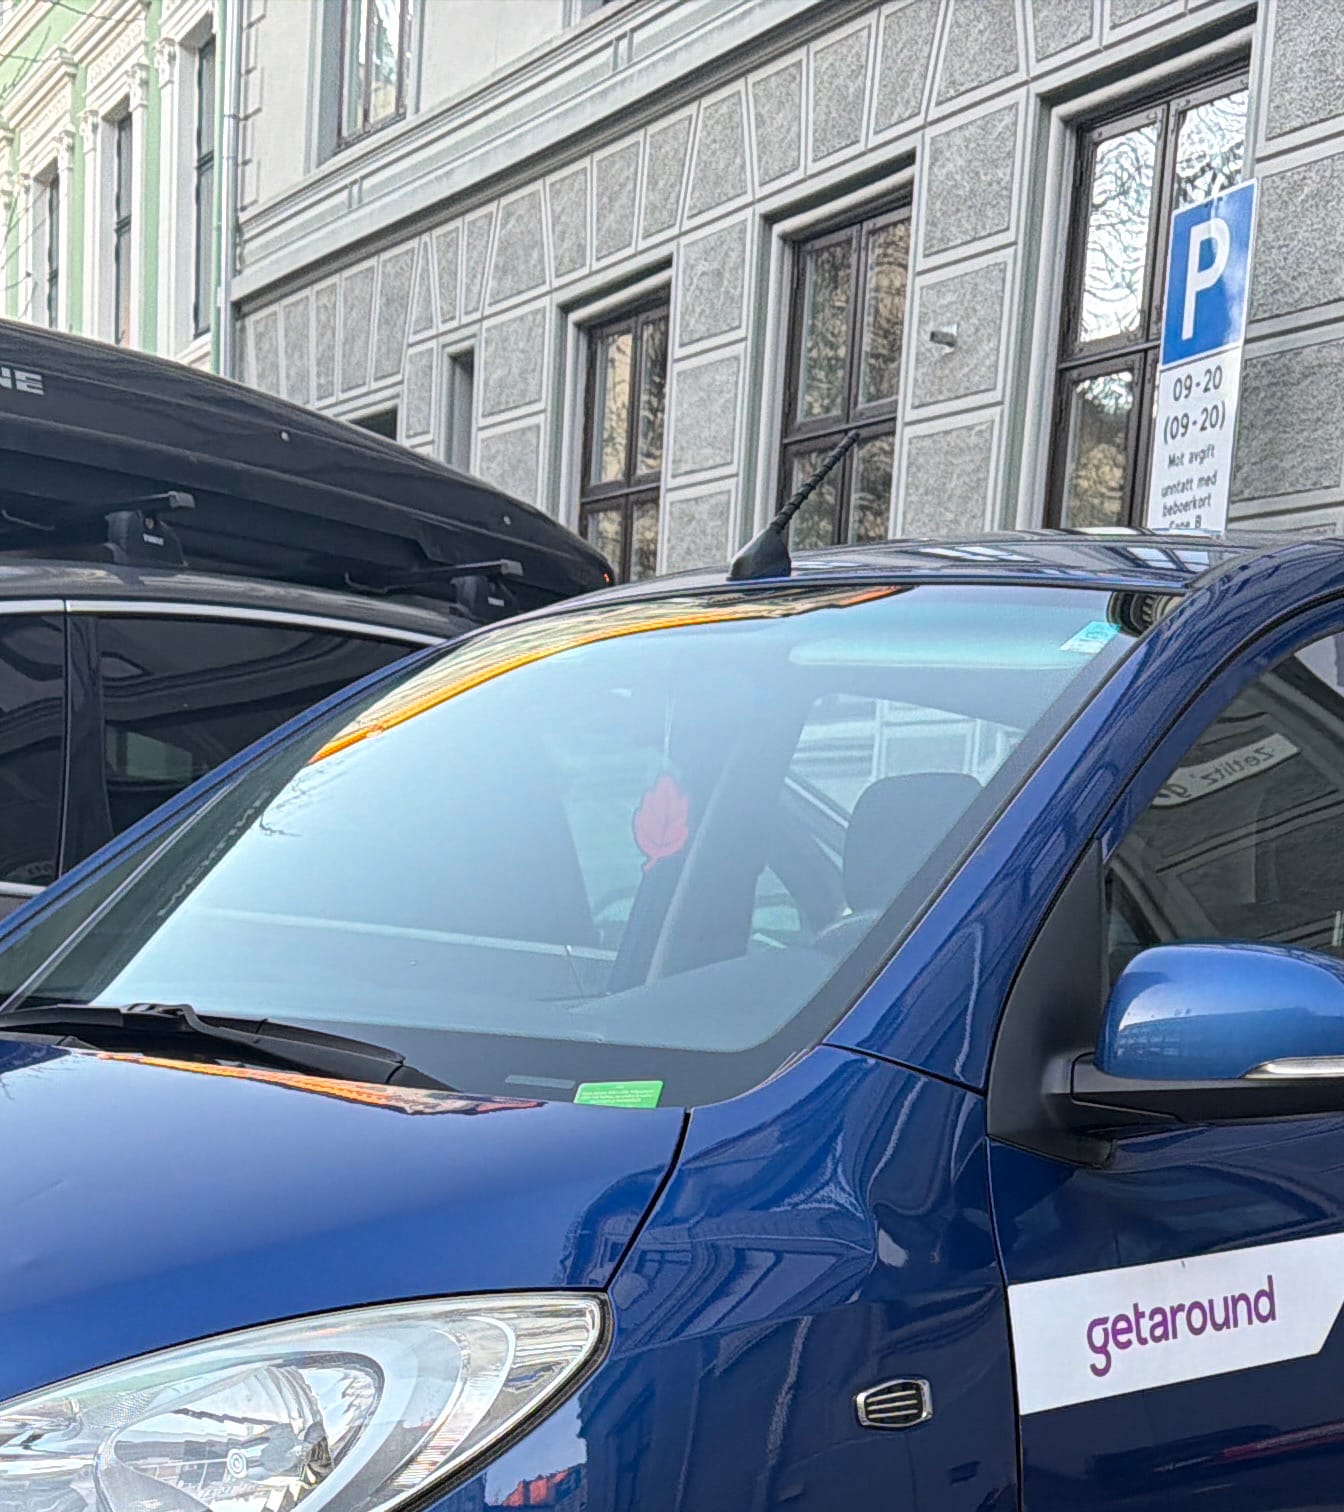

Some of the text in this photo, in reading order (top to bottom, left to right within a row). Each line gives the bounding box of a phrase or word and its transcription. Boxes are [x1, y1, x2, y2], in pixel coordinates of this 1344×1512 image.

[1181, 217, 1231, 341] P
[1168, 444, 1215, 468] Mot avgift
[1161, 469, 1217, 498] unntatt med
[1162, 492, 1212, 517] beboerkort
[1086, 1274, 1276, 1377] getaround
